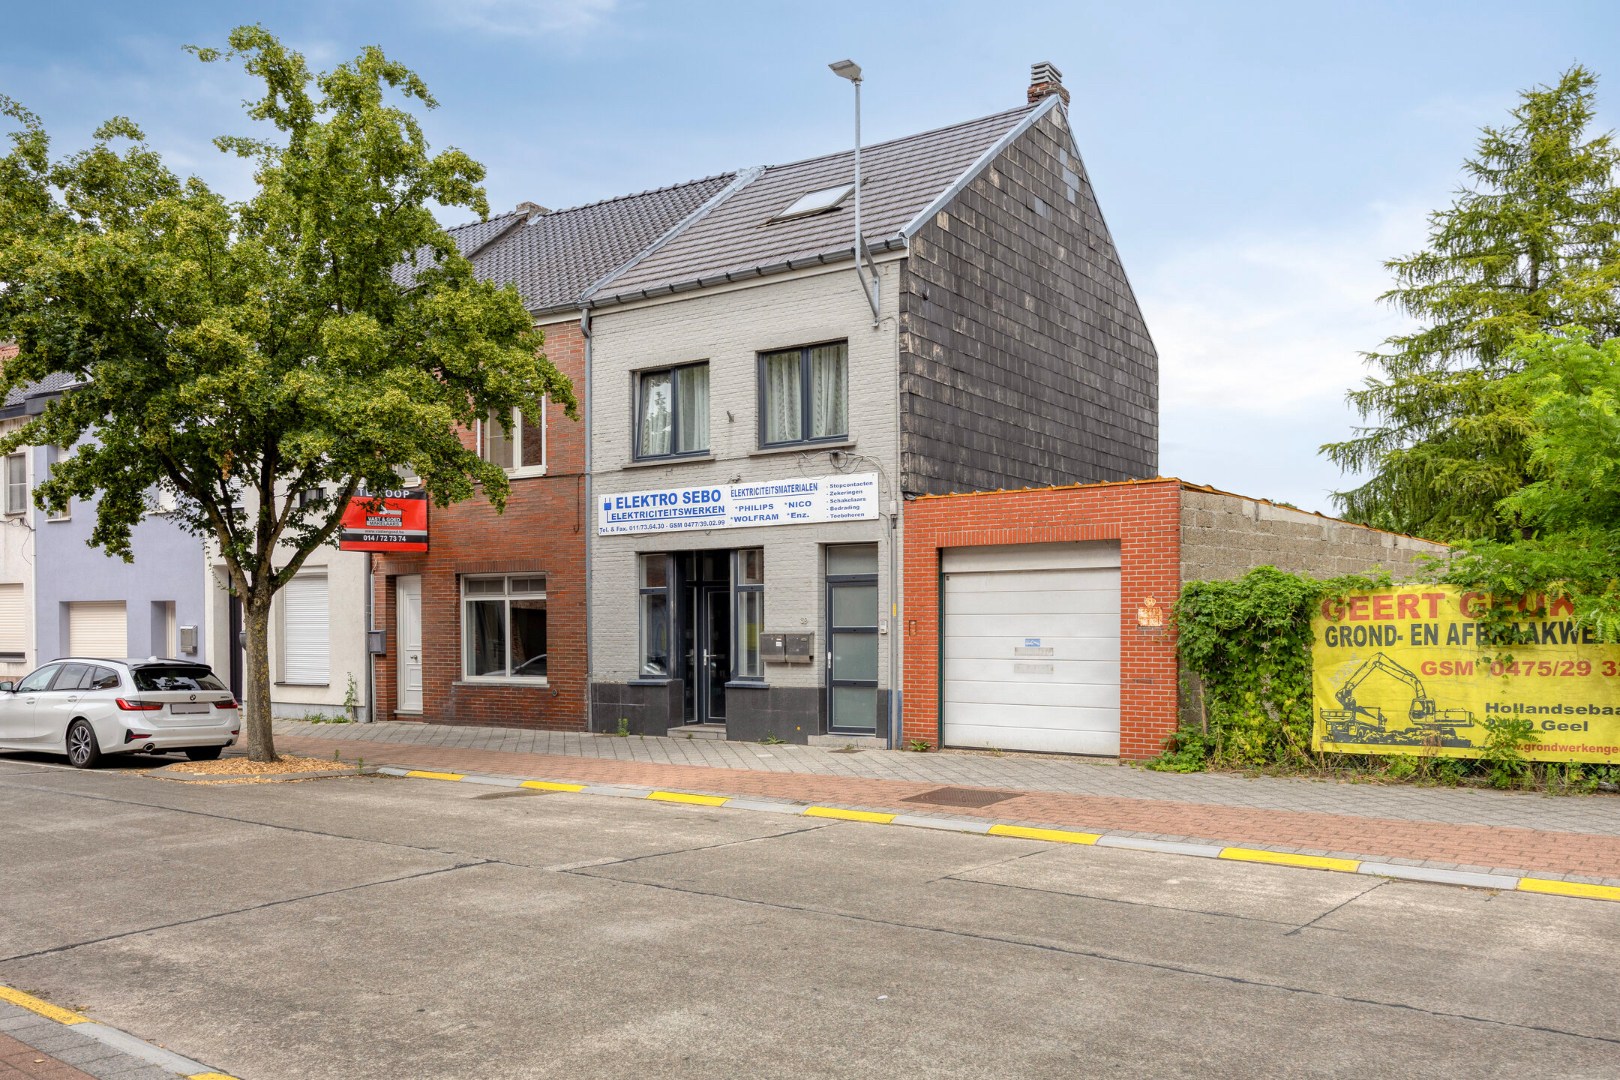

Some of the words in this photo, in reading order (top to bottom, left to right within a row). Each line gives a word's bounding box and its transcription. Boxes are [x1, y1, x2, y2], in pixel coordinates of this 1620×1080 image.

[730, 482, 818, 498] ELEKTRICITEITSMATERIALEN
[616, 492, 678, 510] ELEKTRO
[682, 489, 721, 505] SEBO
[788, 500, 812, 509] NICO
[611, 505, 725, 520] ELEKTRICITEITSWERKEN
[738, 503, 774, 512] PHILIPS
[733, 513, 779, 523] WOLFRAM
[1321, 592, 1445, 621] GEERT
[1325, 625, 1403, 647] GROND-
[1411, 623, 1438, 646] EN
[1421, 661, 1473, 676] GSM
[1491, 660, 1591, 677] 0475/29
[1541, 720, 1588, 732] Geel
